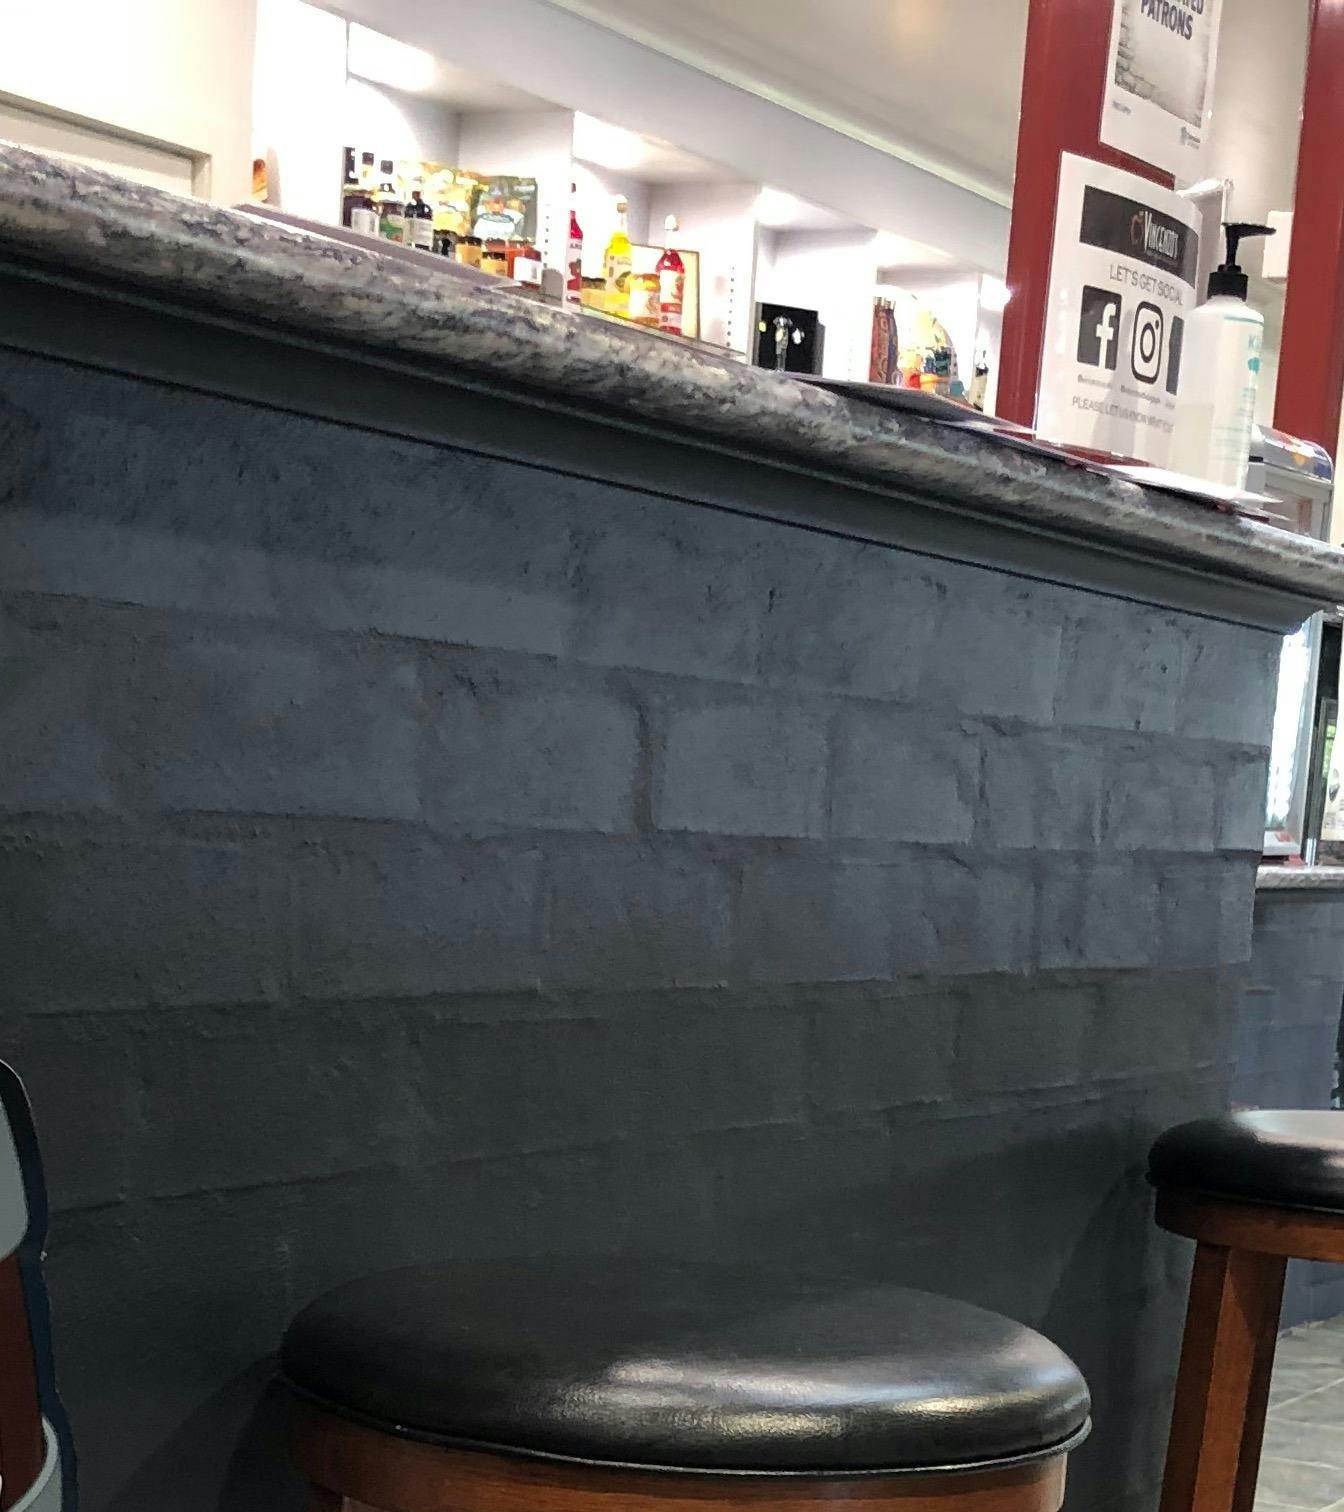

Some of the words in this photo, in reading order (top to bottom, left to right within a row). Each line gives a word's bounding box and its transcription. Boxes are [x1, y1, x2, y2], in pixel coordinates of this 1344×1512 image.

[1140, 0, 1194, 41] PATRONS
[1109, 263, 1138, 287] LET'S
[1140, 273, 1157, 294] GET
